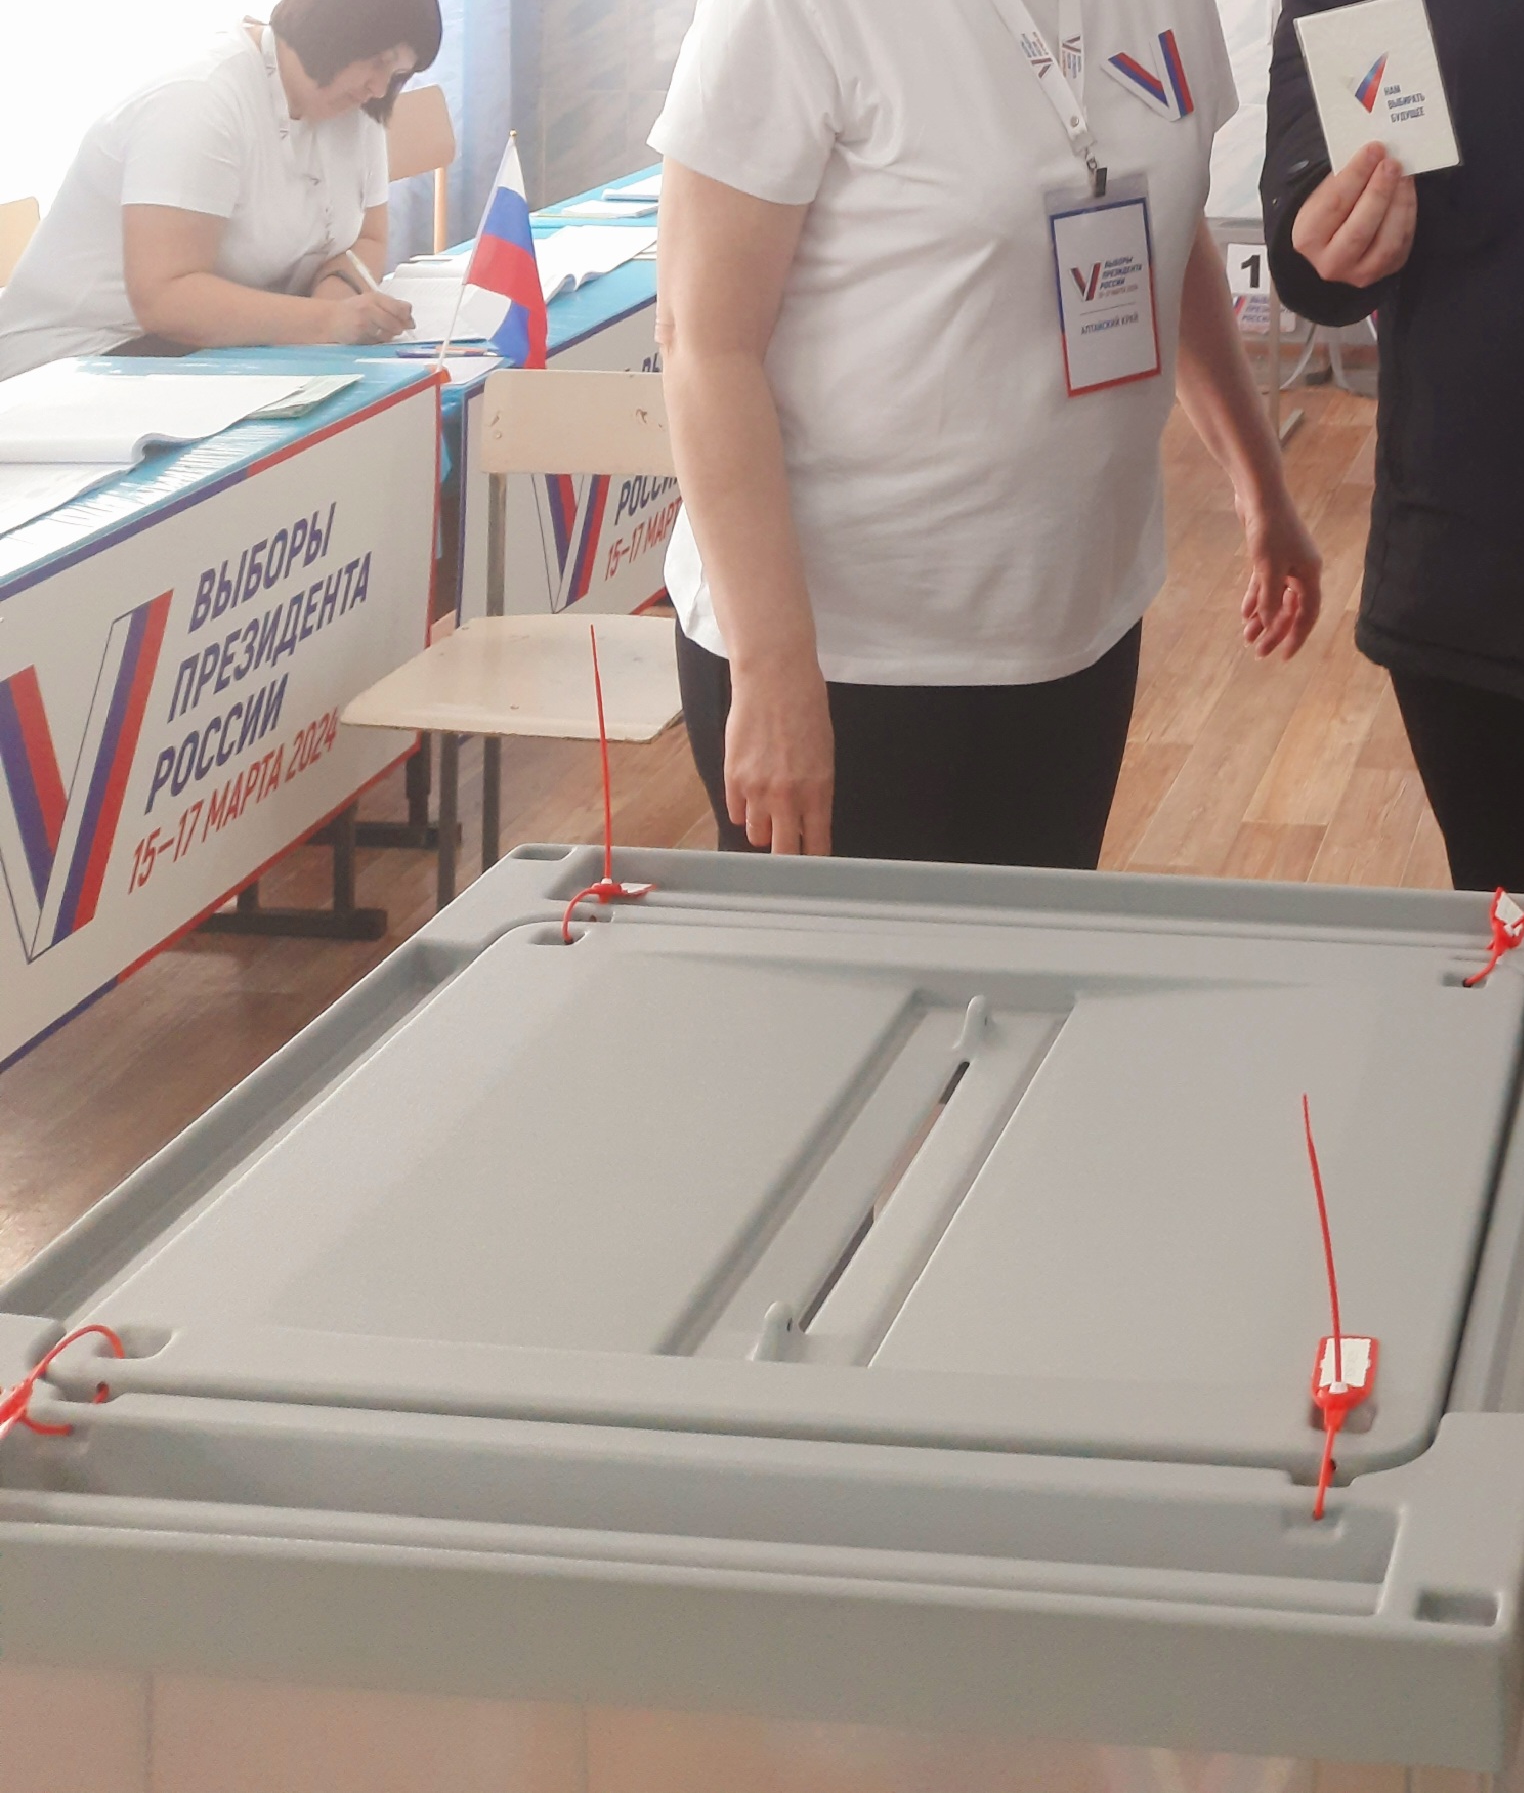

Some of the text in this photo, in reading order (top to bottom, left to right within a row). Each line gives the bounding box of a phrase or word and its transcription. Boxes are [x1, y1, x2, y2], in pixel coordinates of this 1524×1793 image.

[1384, 84, 1401, 96] НАМ
[1387, 92, 1425, 110] ВЫБИРАТЬ
[1390, 106, 1425, 124] БУДУЩЕЕ
[1241, 254, 1261, 288] 1
[643, 496, 683, 554] МАРТ
[187, 501, 337, 634] ВЫБОРЫ
[167, 551, 372, 724] ПРЕЗИДЕНТА
[144, 672, 289, 815] РОССИИ
[202, 743, 286, 843] МАРТА
[285, 707, 338, 783] 2024
